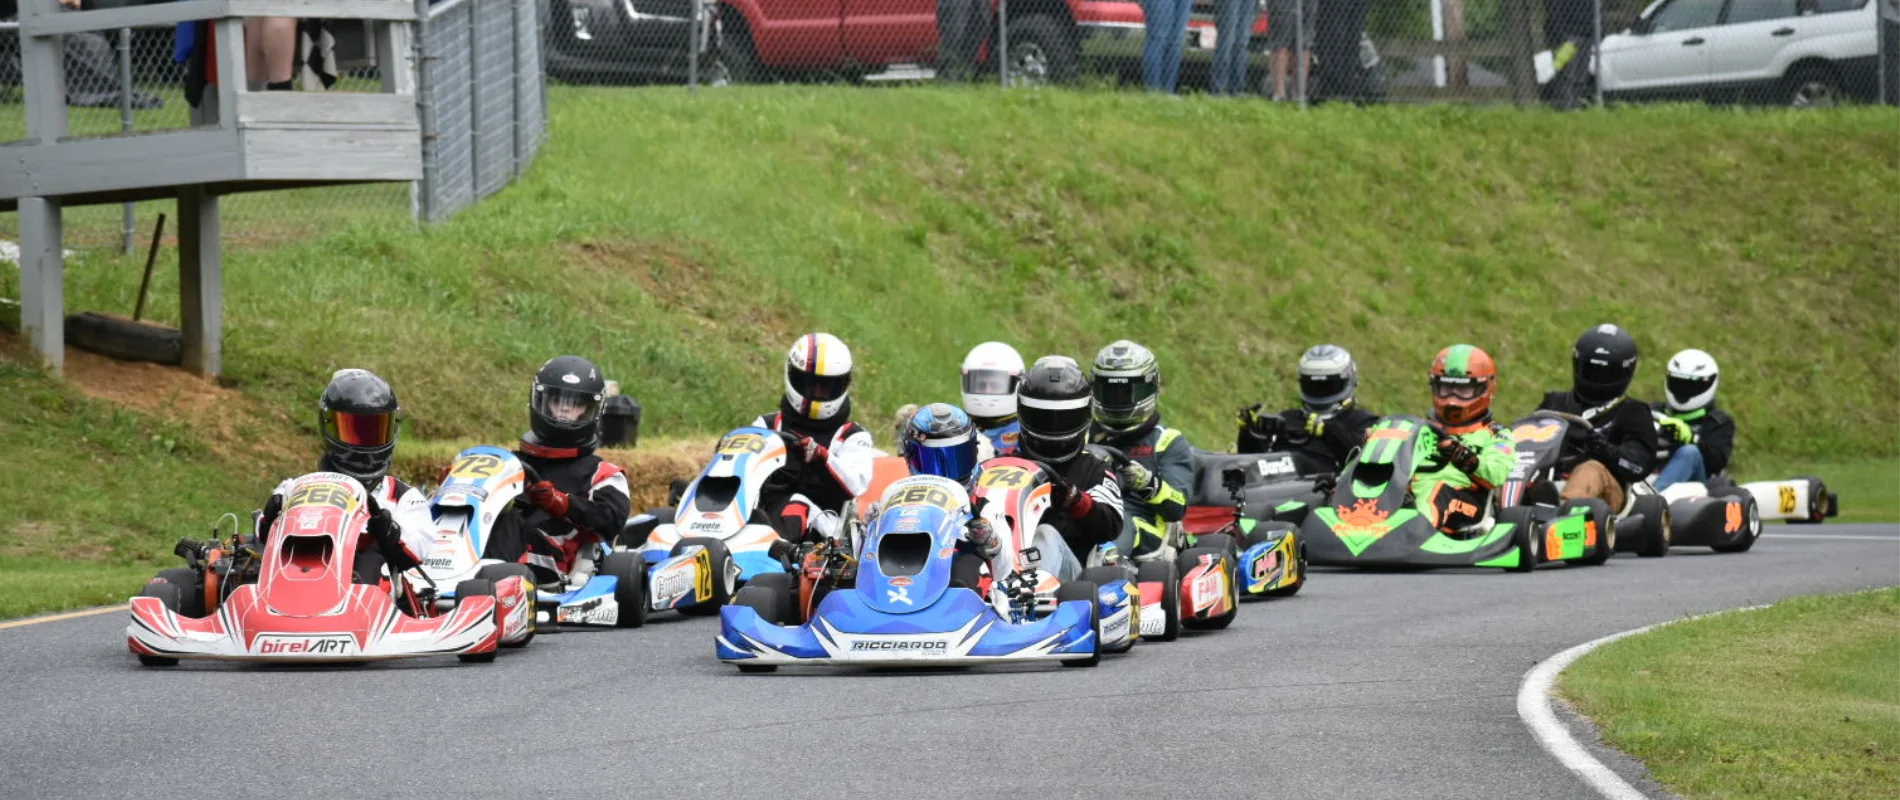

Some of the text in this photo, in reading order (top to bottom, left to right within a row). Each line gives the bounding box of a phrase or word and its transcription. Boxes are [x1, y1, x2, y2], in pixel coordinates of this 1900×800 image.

[452, 456, 499, 477] 72
[986, 469, 1025, 486] 74
[288, 487, 348, 510] 266
[884, 488, 948, 510] 260
[690, 521, 721, 532] Coyote
[423, 558, 453, 567] oyote
[260, 638, 352, 654] birelART
[852, 640, 948, 650] RICCIARDO
